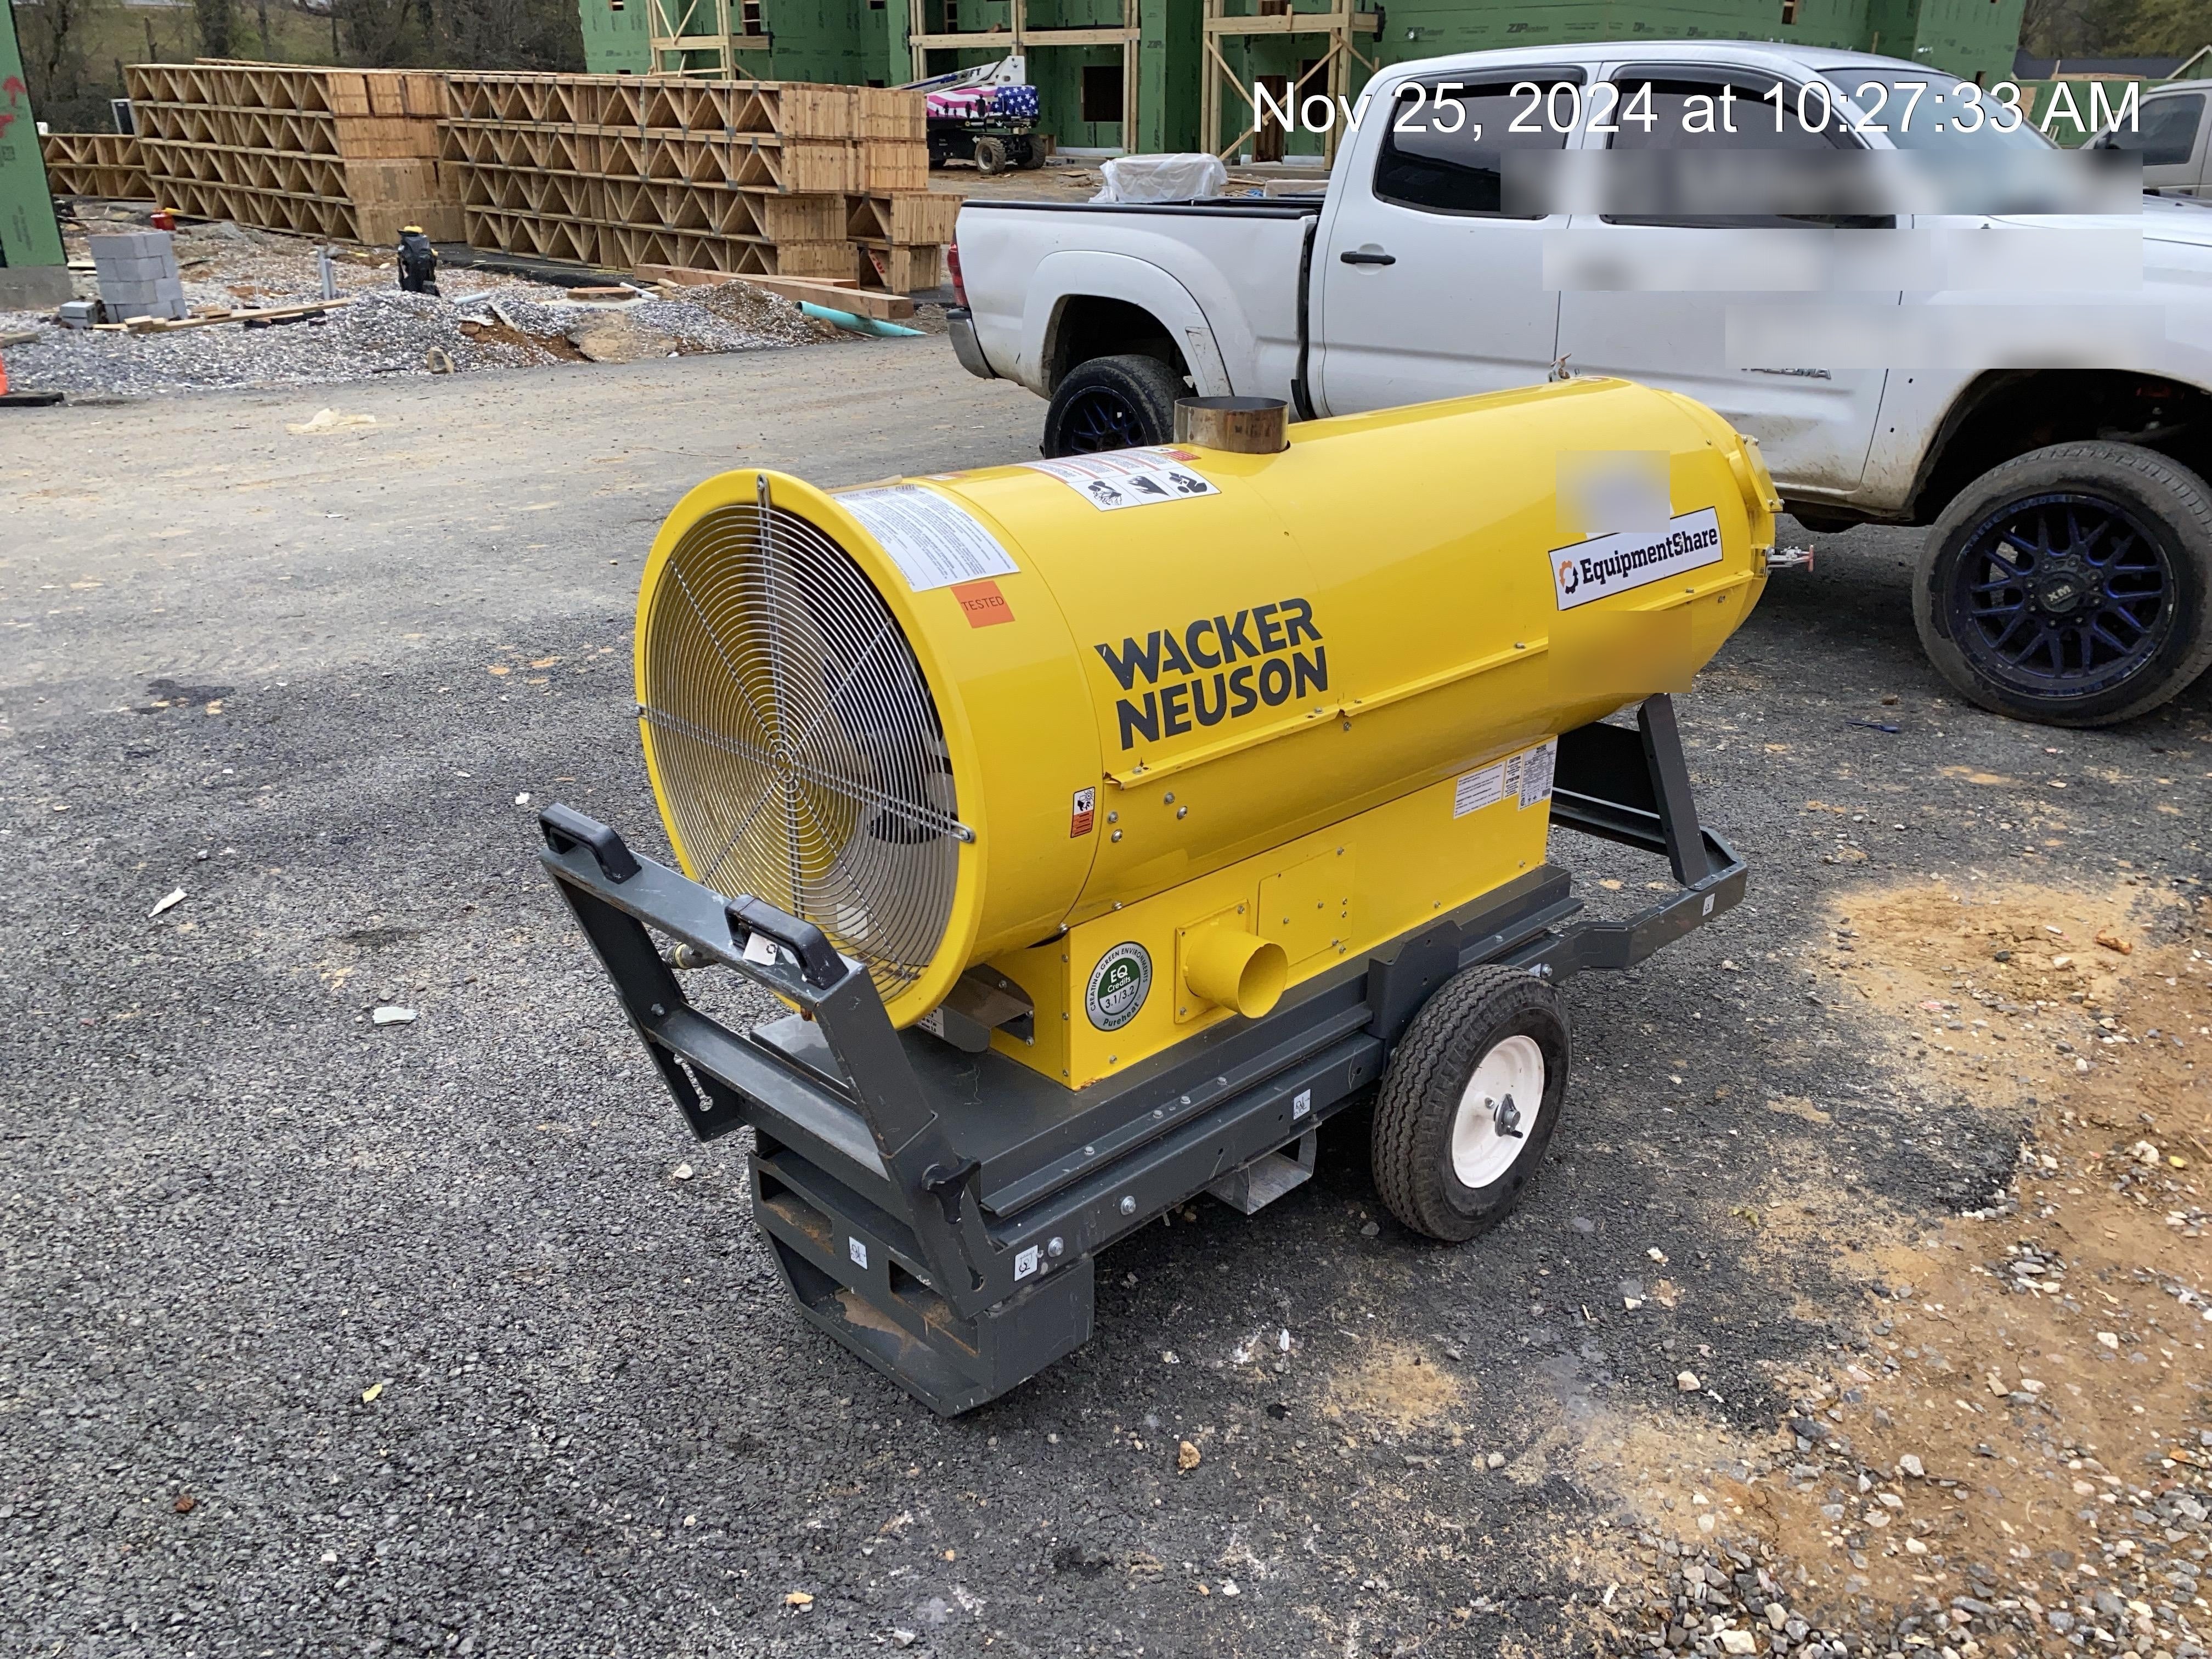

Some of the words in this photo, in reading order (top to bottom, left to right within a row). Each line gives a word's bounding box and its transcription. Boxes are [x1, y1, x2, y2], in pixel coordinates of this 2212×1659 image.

[1579, 528, 1718, 585] EquipmentShare
[961, 596, 1005, 611] TESTED
[1093, 598, 1323, 691] WACKER
[1116, 646, 1328, 751] NEUSON
[1090, 970, 1101, 1012] CREATING
[1101, 951, 1120, 970] GREEN
[1121, 947, 1148, 983] ENVIRONMENTS
[1107, 976, 1131, 993] Credits
[1110, 964, 1128, 984] EQ
[1105, 985, 1135, 1009] 3.1/3.2
